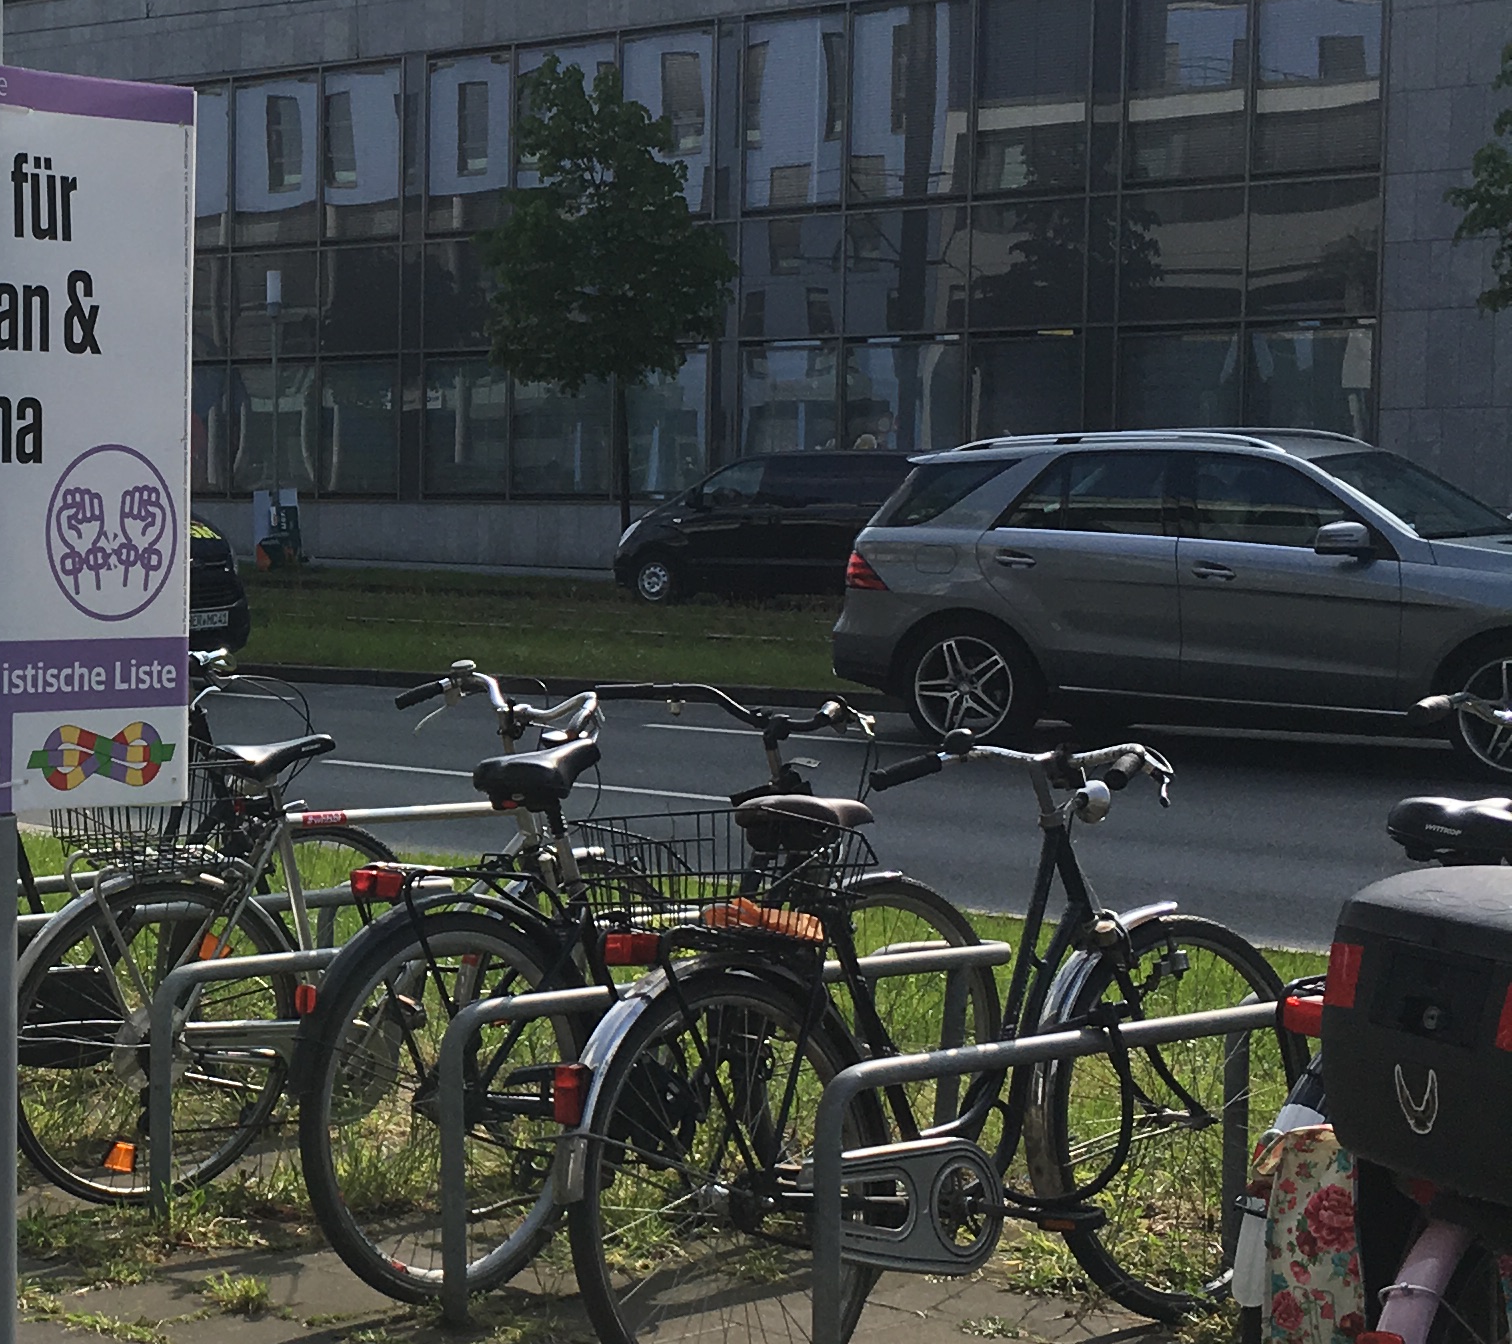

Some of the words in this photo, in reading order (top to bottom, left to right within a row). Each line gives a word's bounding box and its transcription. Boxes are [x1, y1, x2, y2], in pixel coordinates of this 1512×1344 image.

[10, 152, 78, 242] für
[63, 269, 103, 355] &
[114, 658, 177, 691] Liste
